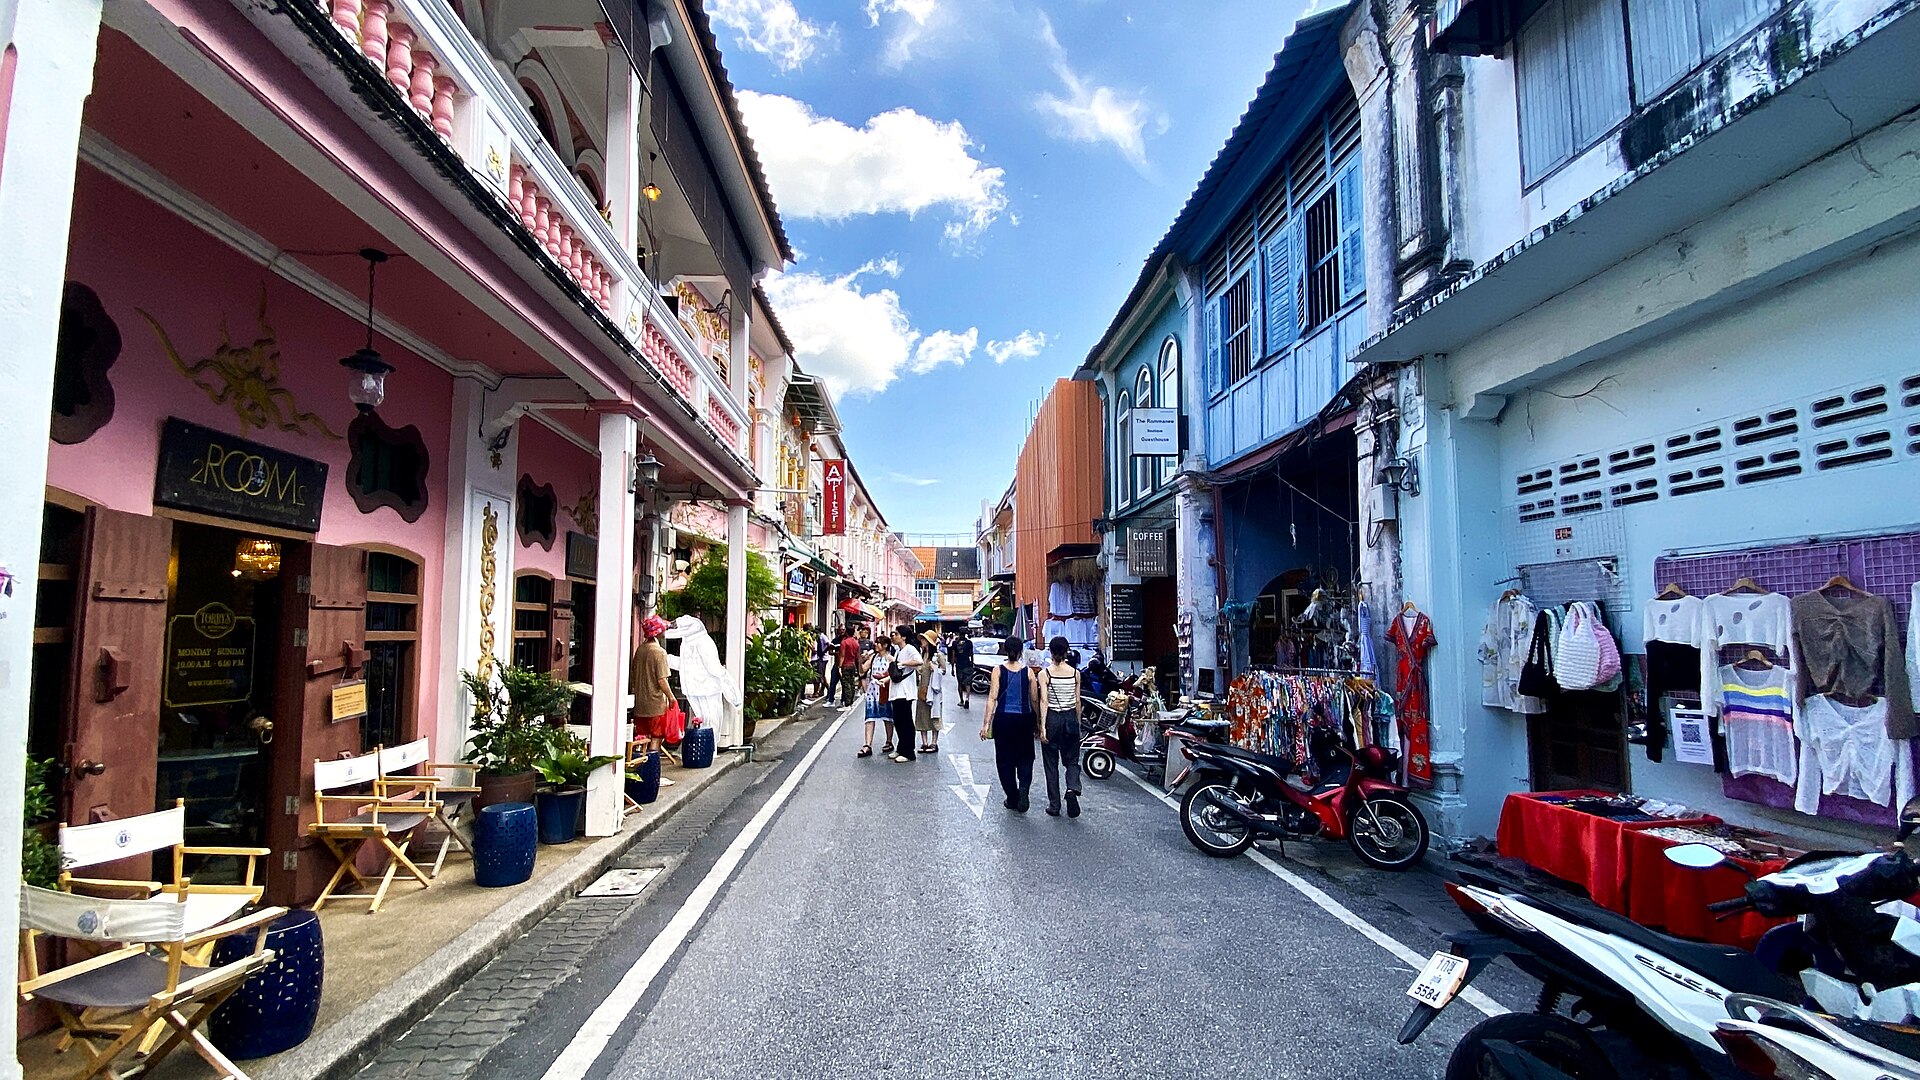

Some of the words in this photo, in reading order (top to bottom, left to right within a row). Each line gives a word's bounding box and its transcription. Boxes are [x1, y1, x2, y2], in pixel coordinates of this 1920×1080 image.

[1133, 532, 1163, 541] COFFEE
[177, 648, 211, 656] MONDAY
[217, 647, 246, 656] SUNDAY
[1414, 983, 1441, 1002] 5584
